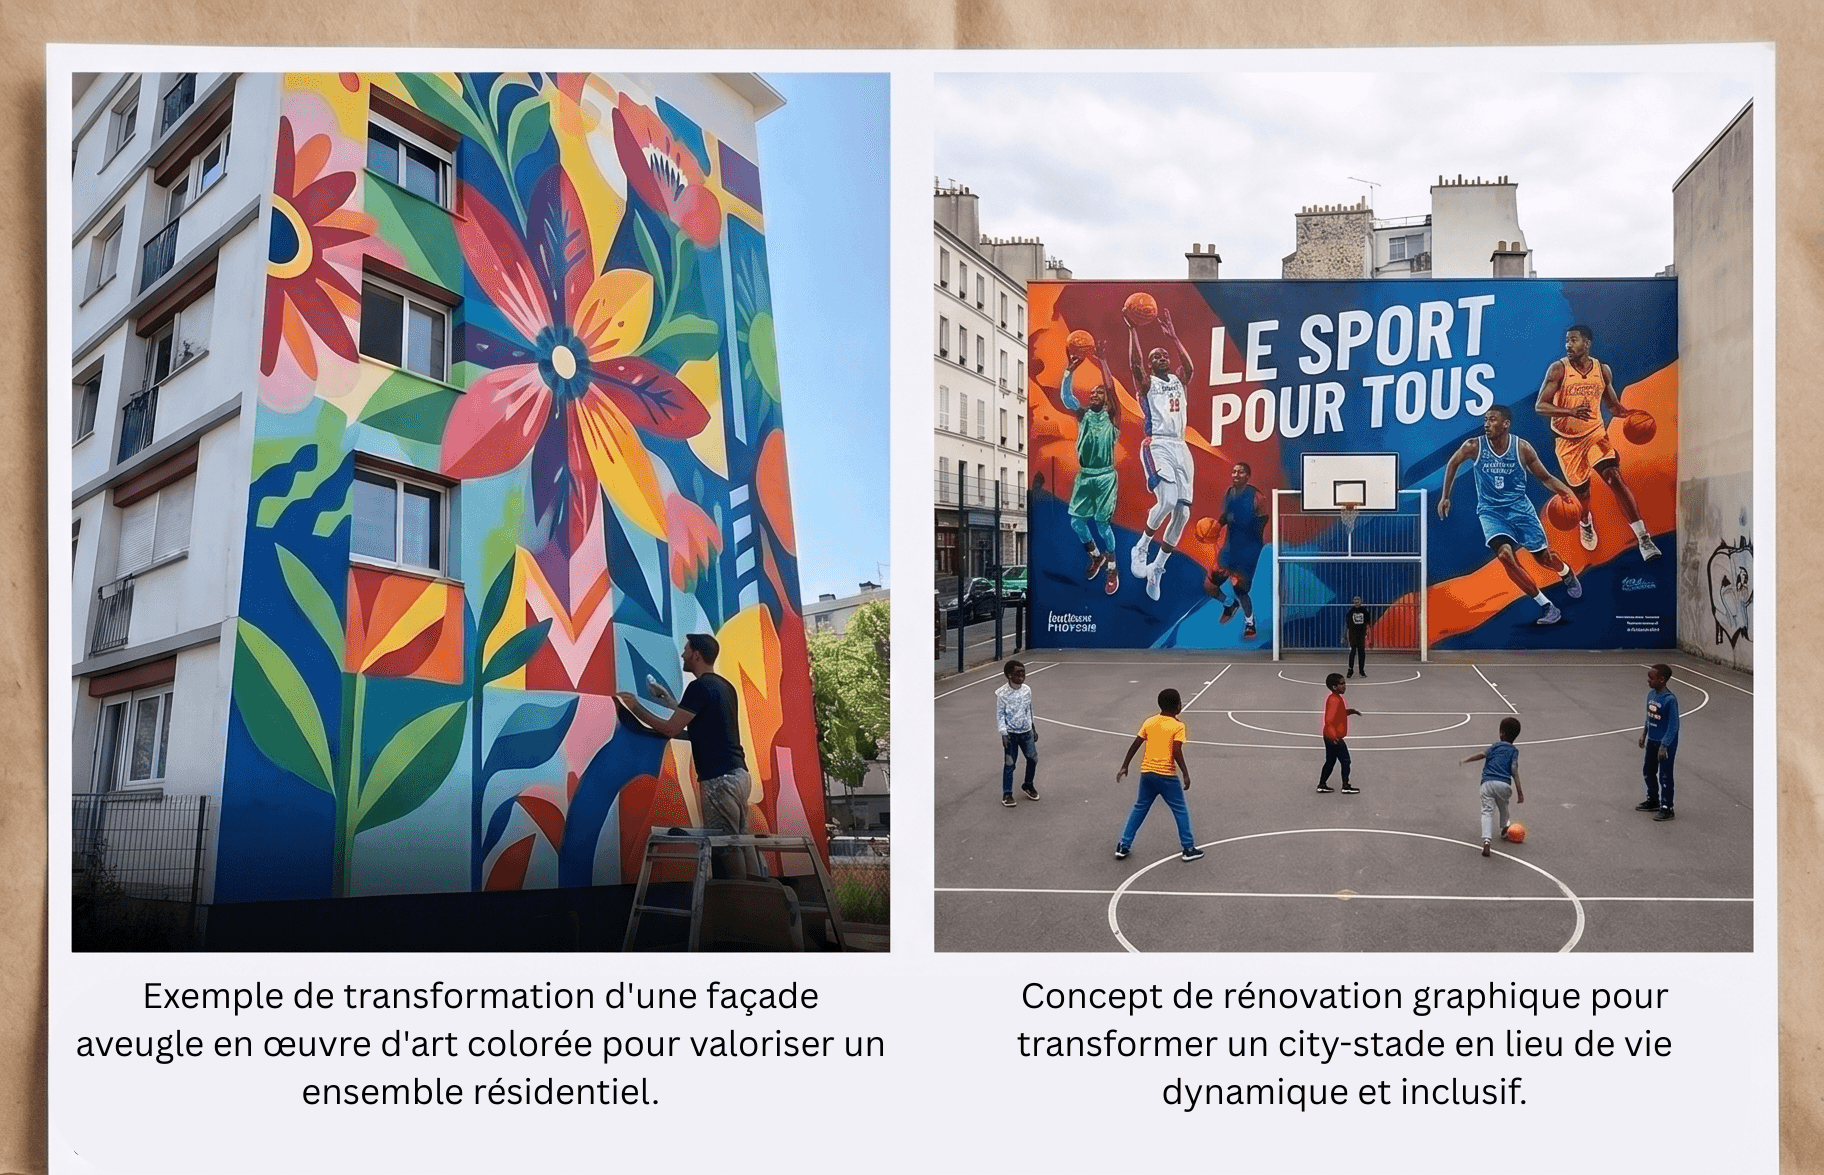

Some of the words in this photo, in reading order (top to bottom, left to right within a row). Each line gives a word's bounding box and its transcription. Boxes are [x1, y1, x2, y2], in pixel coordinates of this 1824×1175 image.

[1209, 320, 1279, 386] LE
[1298, 294, 1496, 375] SPORT
[1211, 381, 1345, 446] POUR
[1363, 363, 1496, 428] TOUS
